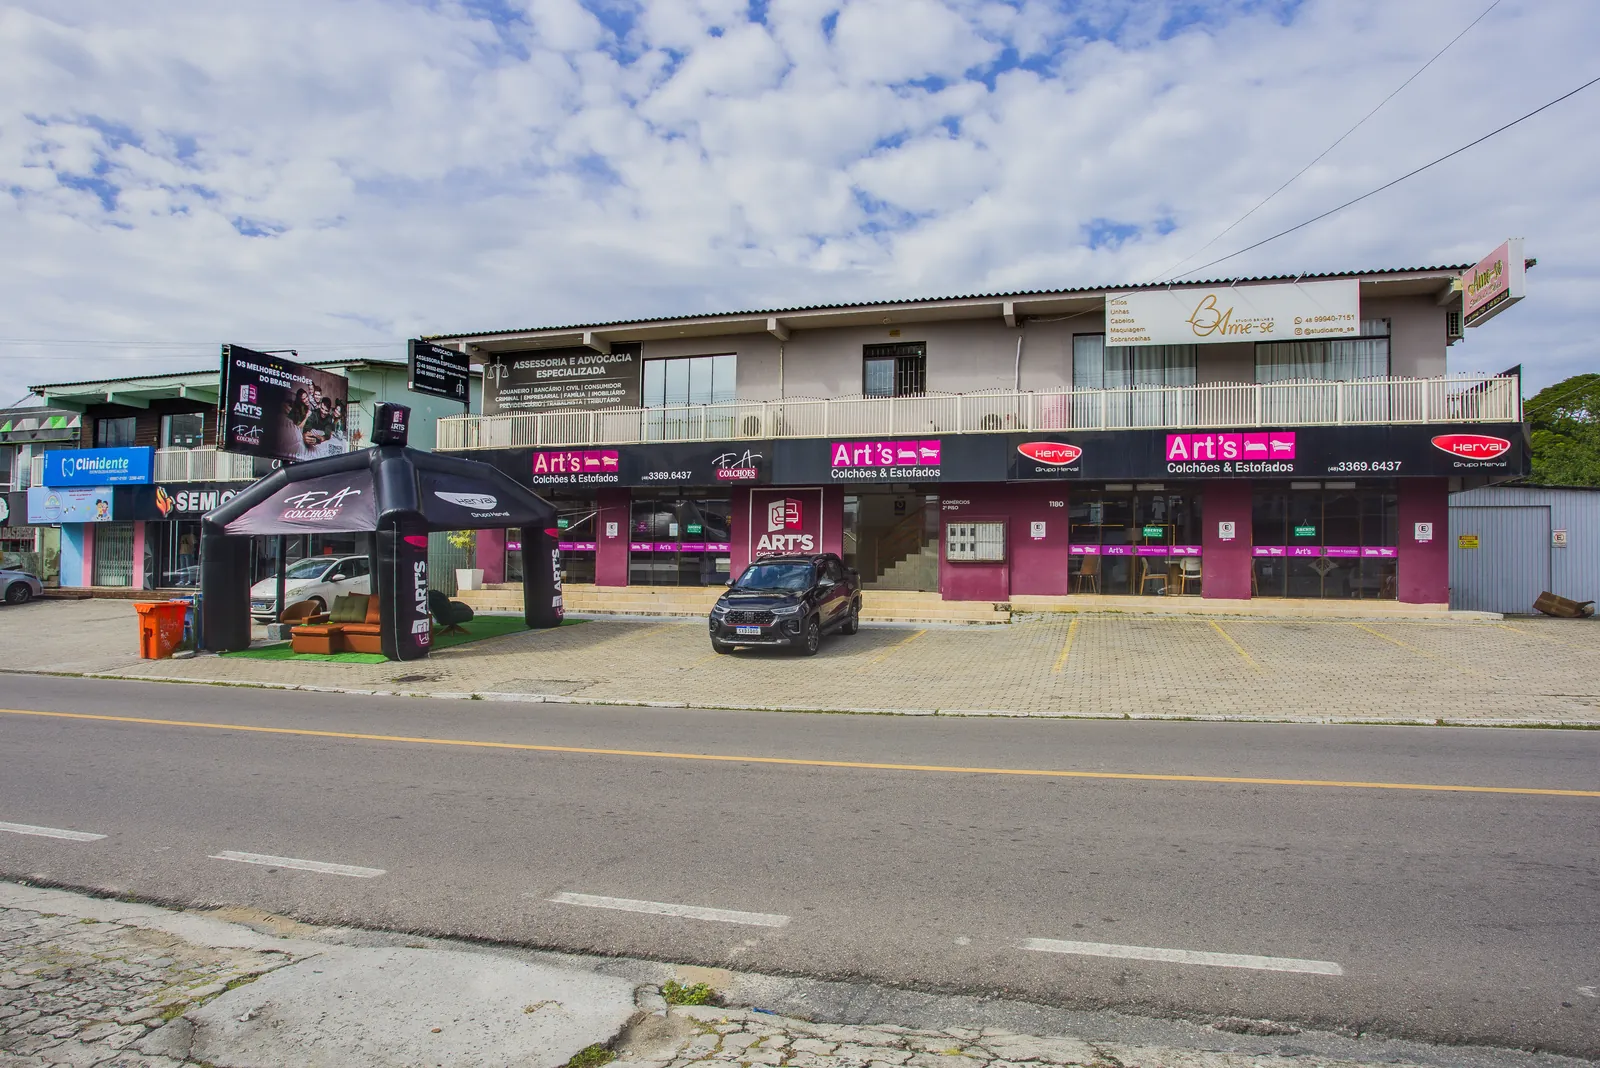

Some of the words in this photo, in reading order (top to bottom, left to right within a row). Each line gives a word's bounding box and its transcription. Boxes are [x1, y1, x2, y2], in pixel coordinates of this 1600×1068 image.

[513, 358, 567, 369] ASSESSORIA
[569, 357, 575, 365] E
[577, 353, 632, 365] ADVOCACIA
[236, 359, 246, 368] OS
[246, 362, 280, 376] MELHORES
[281, 372, 313, 385] COLCHÕES
[536, 366, 606, 378] ESPECIALIZADA
[259, 375, 269, 383] DO
[270, 377, 291, 388] BRASIL
[233, 402, 262, 416] ART'S
[834, 443, 893, 465] Art's
[1035, 450, 1078, 458] Herval
[1169, 436, 1237, 460] Art's
[1453, 442, 1508, 452] Herval
[76, 457, 129, 470] Clinidente
[535, 454, 580, 472] Art's
[1167, 462, 1220, 473] Colchões
[1223, 462, 1232, 472] &
[1235, 462, 1294, 472] Estofados
[533, 474, 569, 484] Colchões
[570, 475, 577, 483] &
[579, 474, 618, 483] Estofados
[831, 469, 877, 479] Colchões
[880, 468, 887, 478] &
[890, 467, 940, 478] Estofados
[176, 492, 216, 511] SEM
[284, 508, 338, 518] COLCHÕES
[756, 534, 814, 550] ART'S
[552, 548, 562, 592] ART'S
[414, 561, 428, 615] ART'S
